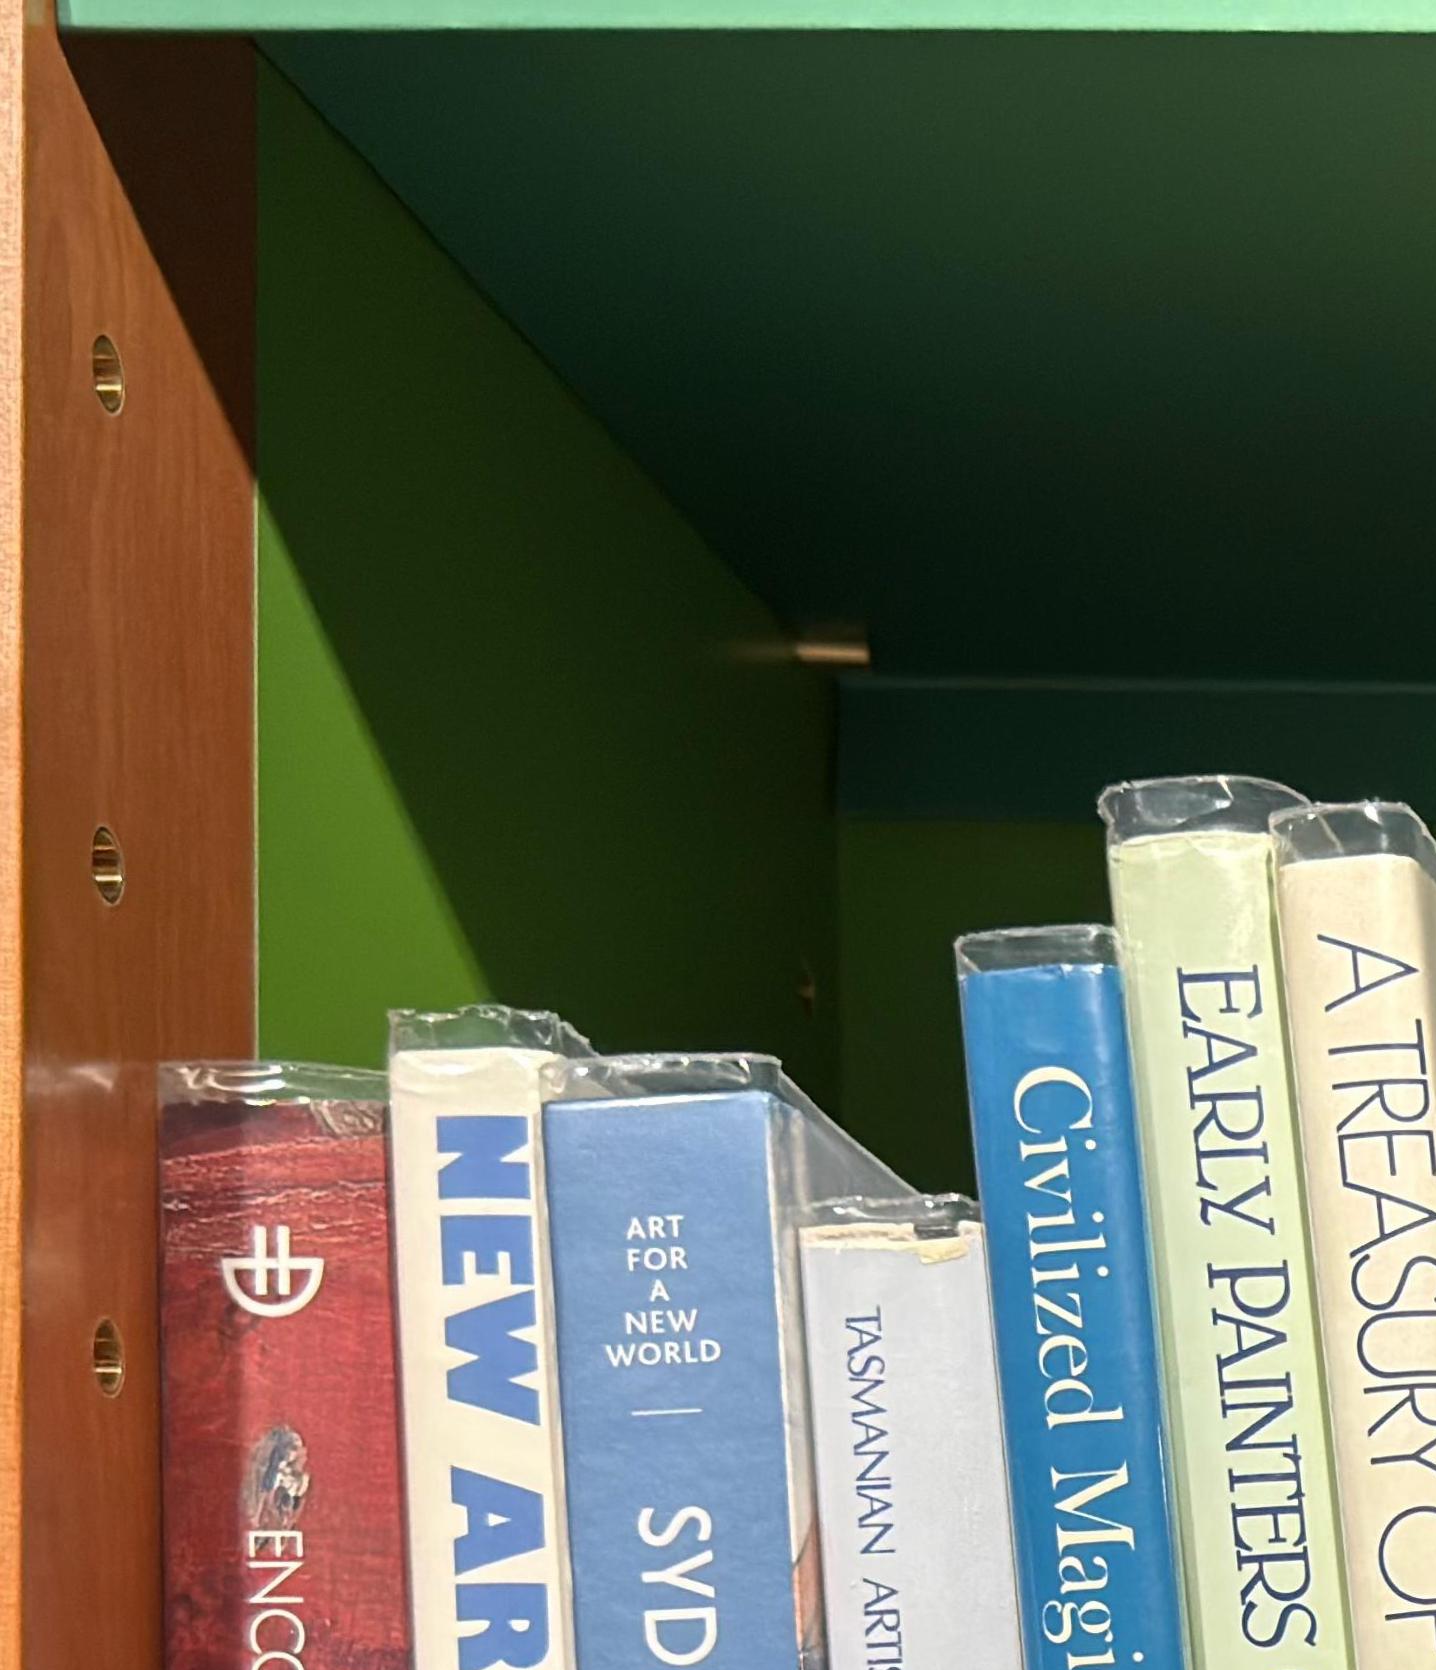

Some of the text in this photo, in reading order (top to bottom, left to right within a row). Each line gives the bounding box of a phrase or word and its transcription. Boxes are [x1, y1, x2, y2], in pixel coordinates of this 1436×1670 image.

[626, 1213, 684, 1242] ART
[626, 1243, 689, 1272] FOR
[1012, 1066, 1122, 1429] Civilized
[648, 1279, 670, 1302] A
[623, 1307, 697, 1335] NEW
[605, 1337, 722, 1367] WORLD
[844, 1306, 895, 1553] TASMANIAN
